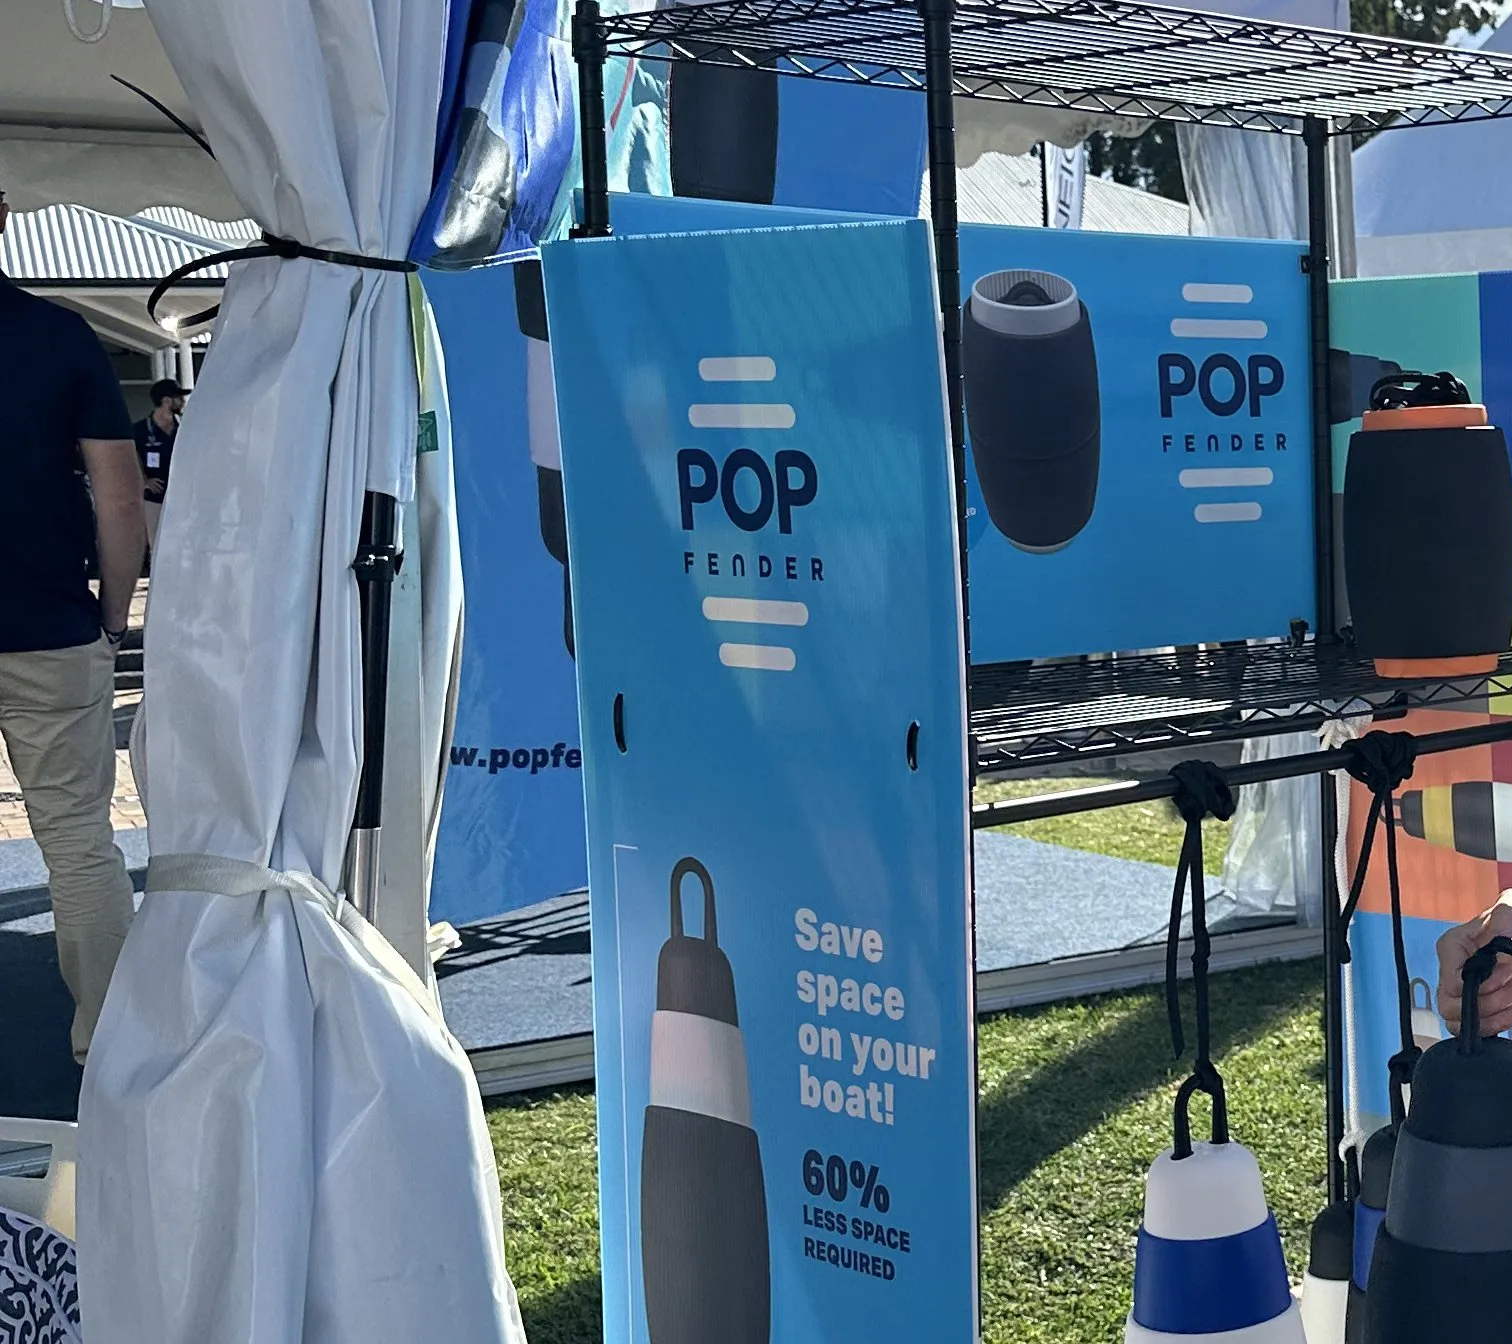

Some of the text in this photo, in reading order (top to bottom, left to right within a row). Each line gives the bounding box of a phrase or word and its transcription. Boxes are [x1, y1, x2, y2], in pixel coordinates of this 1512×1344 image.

[1157, 352, 1285, 418] POP
[677, 448, 818, 534] POP
[794, 907, 884, 963] Save
[797, 969, 905, 1021] space
[798, 1023, 936, 1080] on your
[799, 1064, 895, 1125] boat!
[803, 1149, 890, 1213] 60%
[803, 1204, 911, 1253] LESS SPACE
[804, 1236, 895, 1281] REQUIRED
